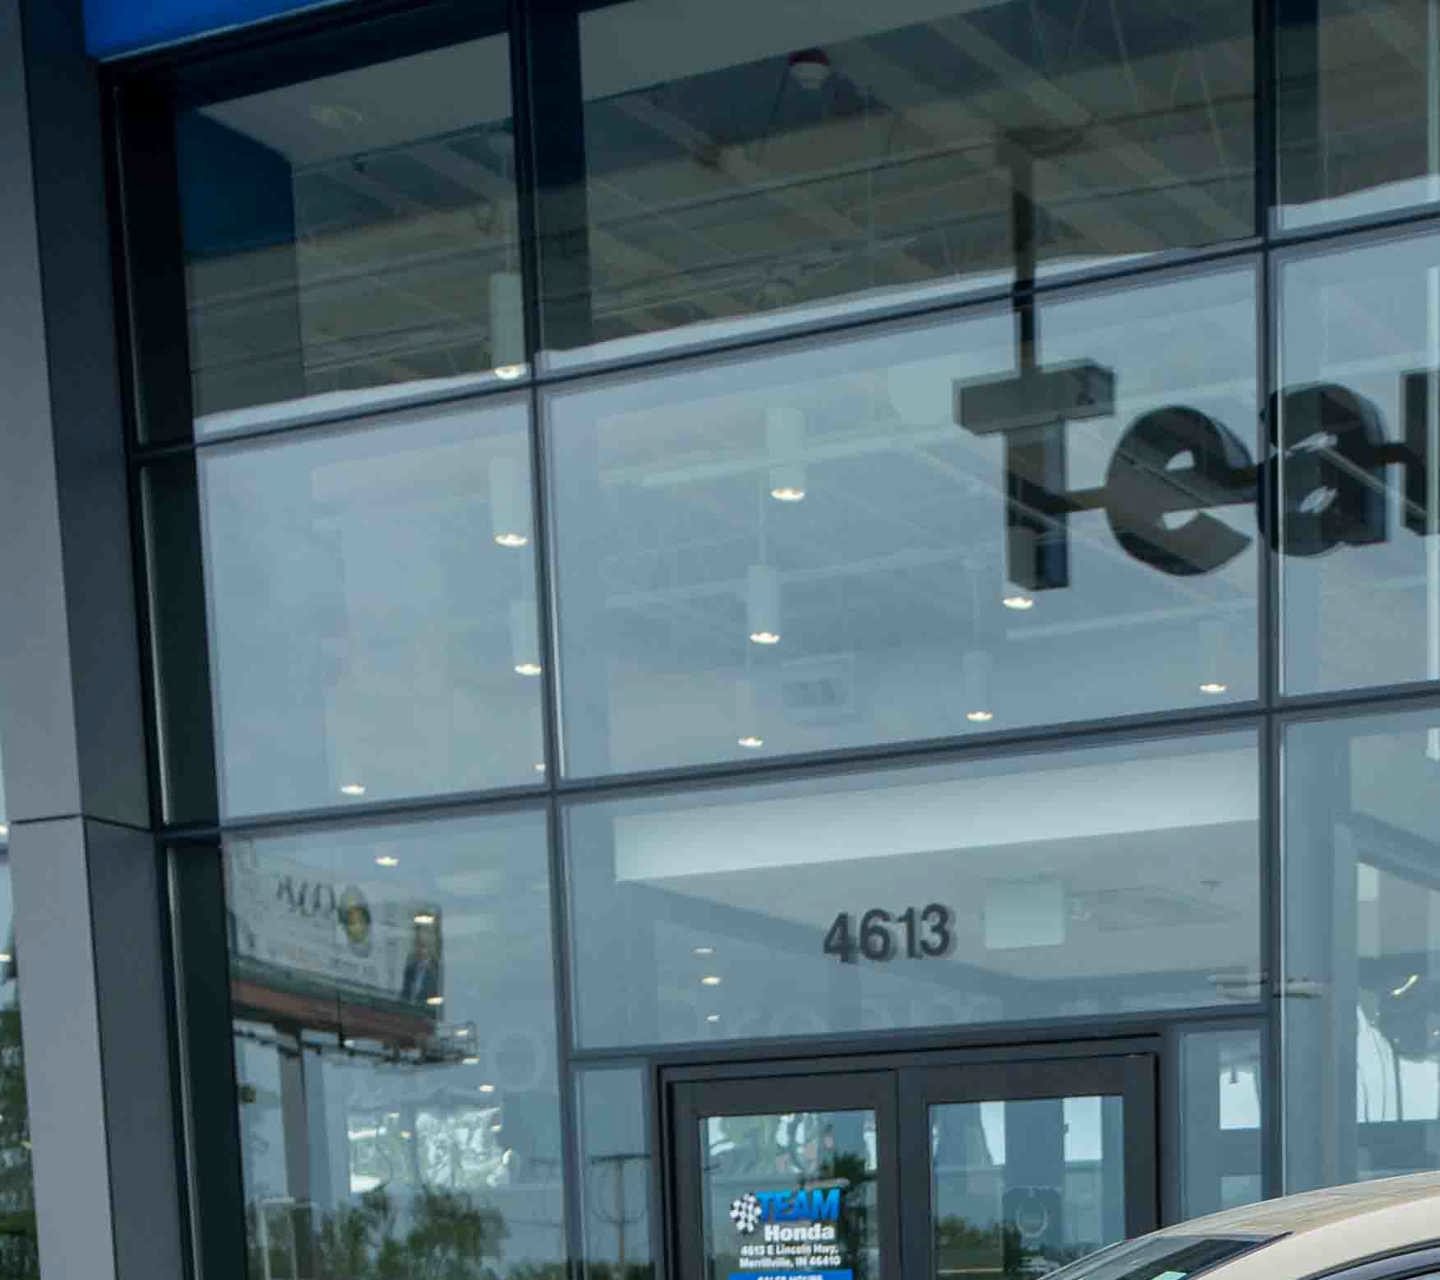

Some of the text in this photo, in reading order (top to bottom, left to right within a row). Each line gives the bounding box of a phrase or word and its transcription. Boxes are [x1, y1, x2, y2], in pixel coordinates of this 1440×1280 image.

[823, 903, 953, 963] 4613
[755, 1189, 841, 1221] TEAM
[764, 1223, 835, 1241] Honda
[776, 1244, 811, 1255] Lincoln
